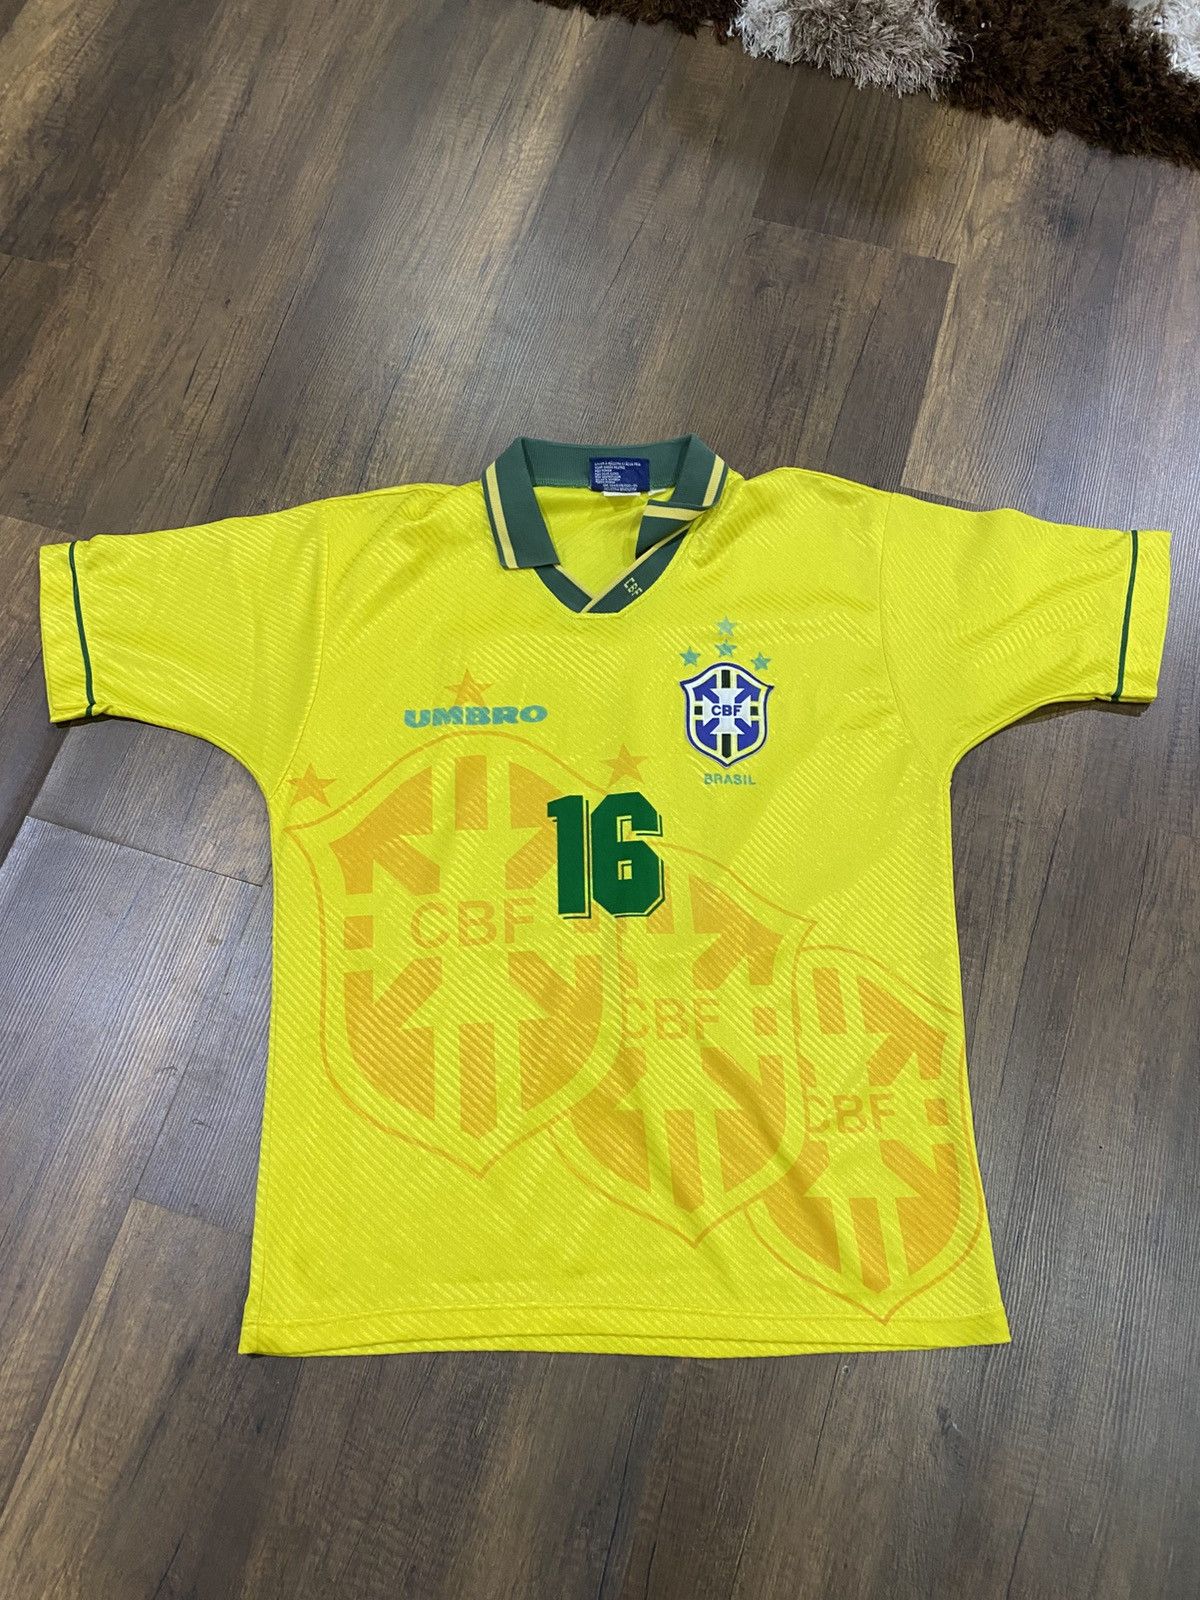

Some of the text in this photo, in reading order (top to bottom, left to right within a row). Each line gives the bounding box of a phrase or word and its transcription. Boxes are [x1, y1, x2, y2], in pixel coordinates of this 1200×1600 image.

[404, 704, 548, 728] UMBRO
[711, 705, 743, 717] CBF
[704, 773, 756, 785] BRASIL
[547, 791, 666, 919] 16
[411, 898, 536, 948] CBF
